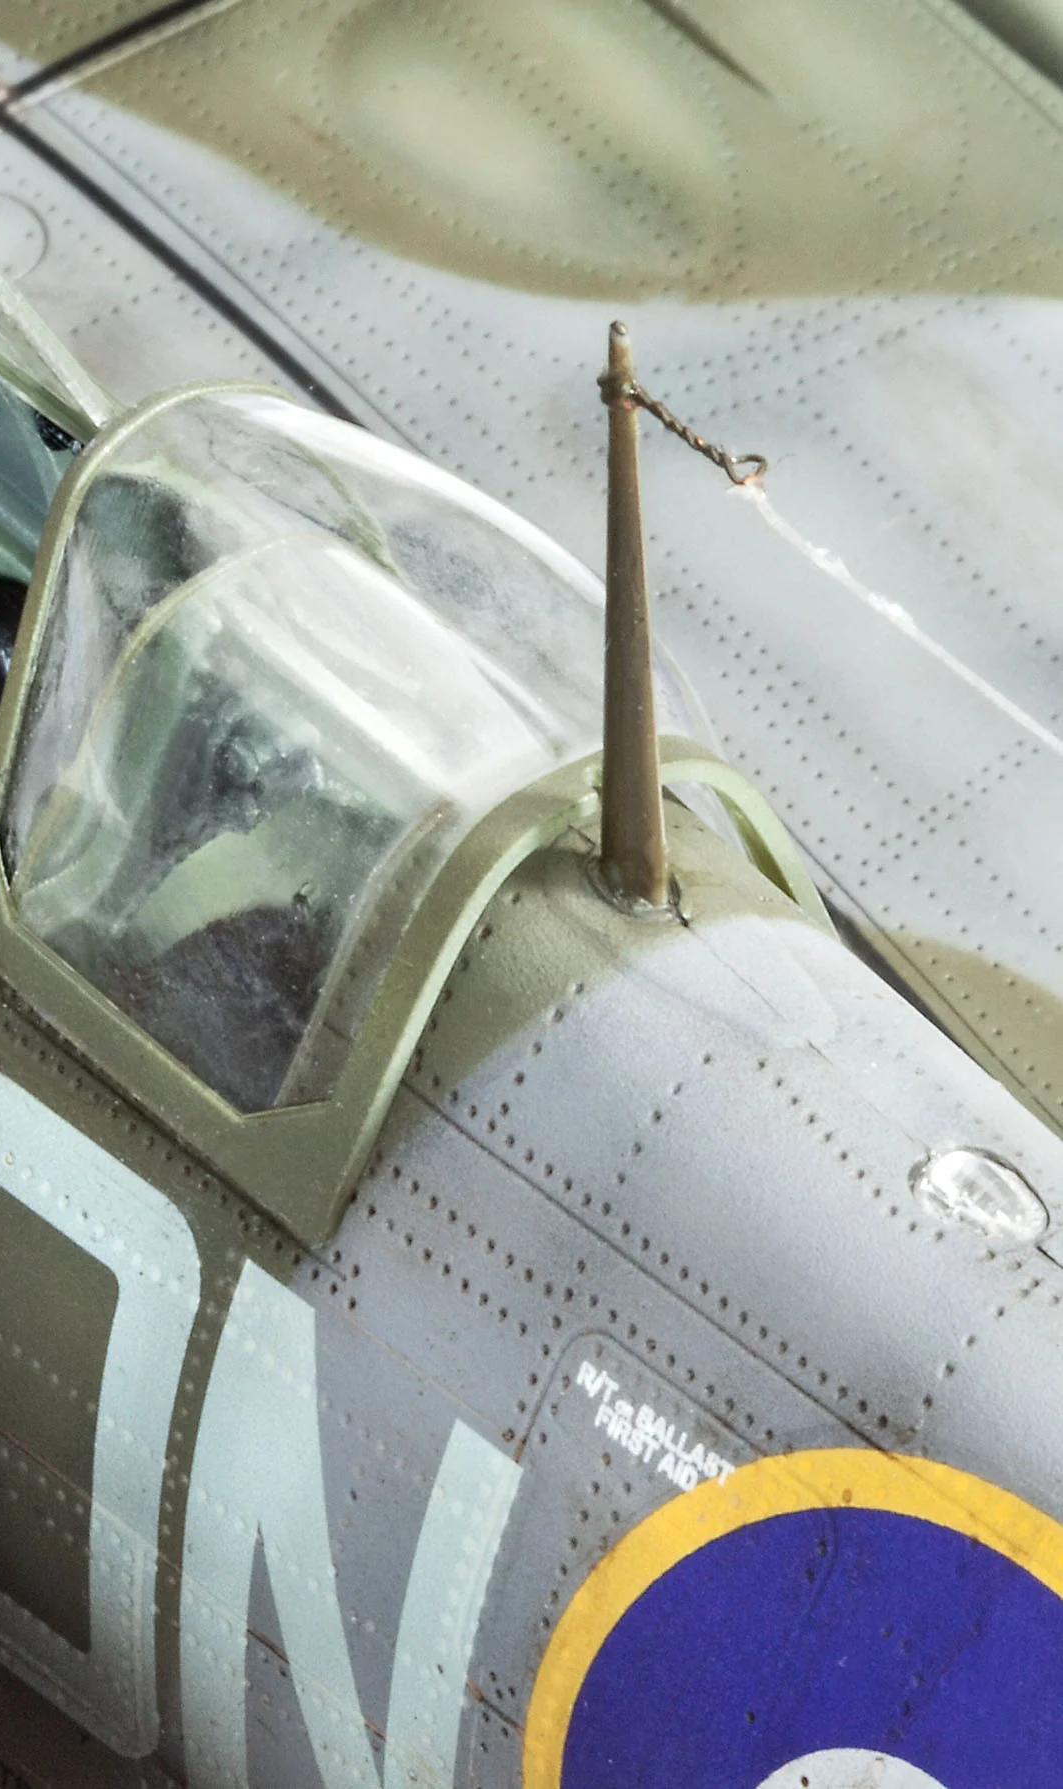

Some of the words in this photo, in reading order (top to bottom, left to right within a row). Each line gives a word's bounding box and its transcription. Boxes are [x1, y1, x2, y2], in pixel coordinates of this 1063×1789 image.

[594, 1403, 661, 1464] FIRST
[656, 1451, 699, 1492] AID
[635, 1403, 737, 1486] BALLAST
